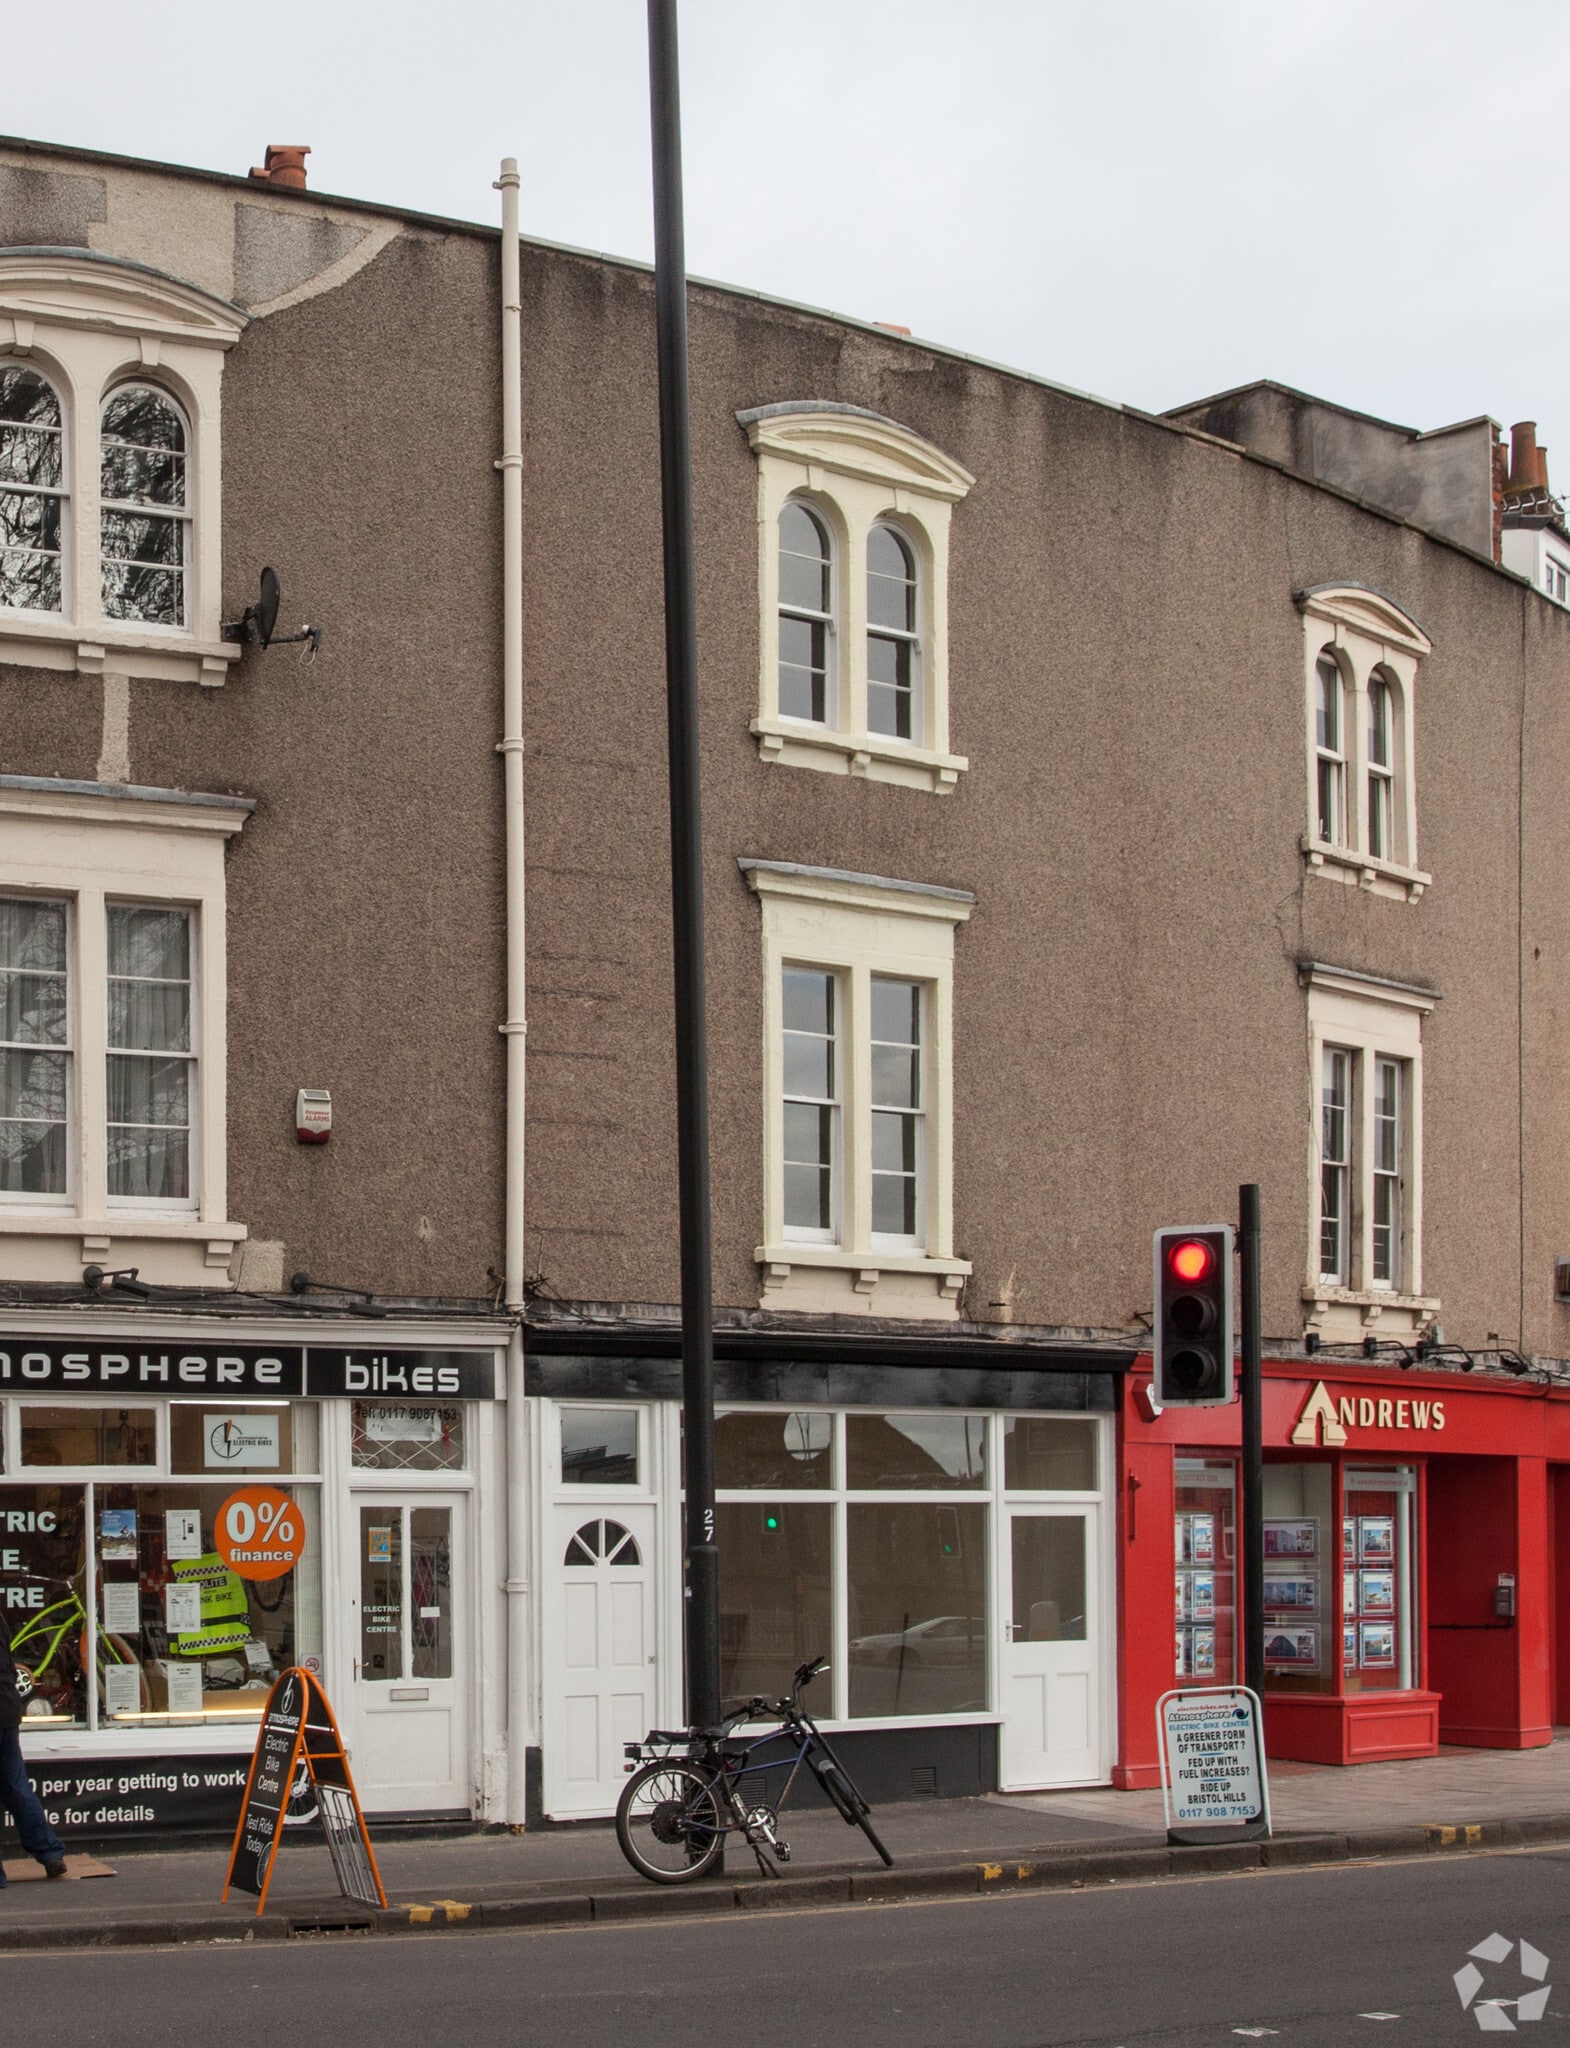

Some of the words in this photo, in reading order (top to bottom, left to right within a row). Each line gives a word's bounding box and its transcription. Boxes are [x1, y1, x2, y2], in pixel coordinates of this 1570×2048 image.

[345, 1355, 460, 1392] bikes
[379, 1407, 406, 1419] 0117
[226, 1501, 295, 1544] 0%
[230, 1548, 294, 1562] finance
[200, 1577, 226, 1589] OLITE
[363, 1605, 400, 1613] ELECTRIC
[372, 1615, 391, 1623] BIKE
[366, 1625, 397, 1633] CENTRE
[1168, 1711, 1231, 1722] Atmosphere
[1168, 1722, 1201, 1731] ELECTRIC
[1203, 1721, 1219, 1729] BIKE
[1222, 1720, 1249, 1728] CENTRE
[1176, 1733, 1182, 1743] A
[1183, 1731, 1221, 1742] GREENER
[1223, 1729, 1245, 1739] FORM
[265, 1734, 289, 1753] Electric
[1178, 1744, 1188, 1753] OF
[1191, 1741, 1239, 1752] TRANSPORT
[265, 1755, 280, 1772] Bike
[1188, 1758, 1203, 1768] FED
[1205, 1757, 1215, 1766] UP
[1217, 1756, 1238, 1766] WITH
[1179, 1769, 1199, 1779] FUEL
[1200, 1766, 1250, 1778] INCREASES?
[42, 1778, 71, 1797] per
[76, 1777, 113, 1796] year
[118, 1773, 177, 1793] getting
[182, 1772, 199, 1788] to
[204, 1770, 246, 1786] work
[257, 1774, 279, 1793] Centre
[1200, 1782, 1218, 1792] RIDE
[1220, 1782, 1231, 1791] UP
[1188, 1794, 1222, 1804] BRISTOL
[1224, 1792, 1246, 1802] HILLS
[65, 1808, 90, 1824] for
[95, 1805, 155, 1823] details
[1179, 1808, 1202, 1818] 0117
[1206, 1807, 1227, 1816] 908
[1231, 1806, 1256, 1815] 7153
[246, 1813, 259, 1831] Test
[258, 1817, 273, 1835] Ride
[245, 1835, 264, 1857] Today
